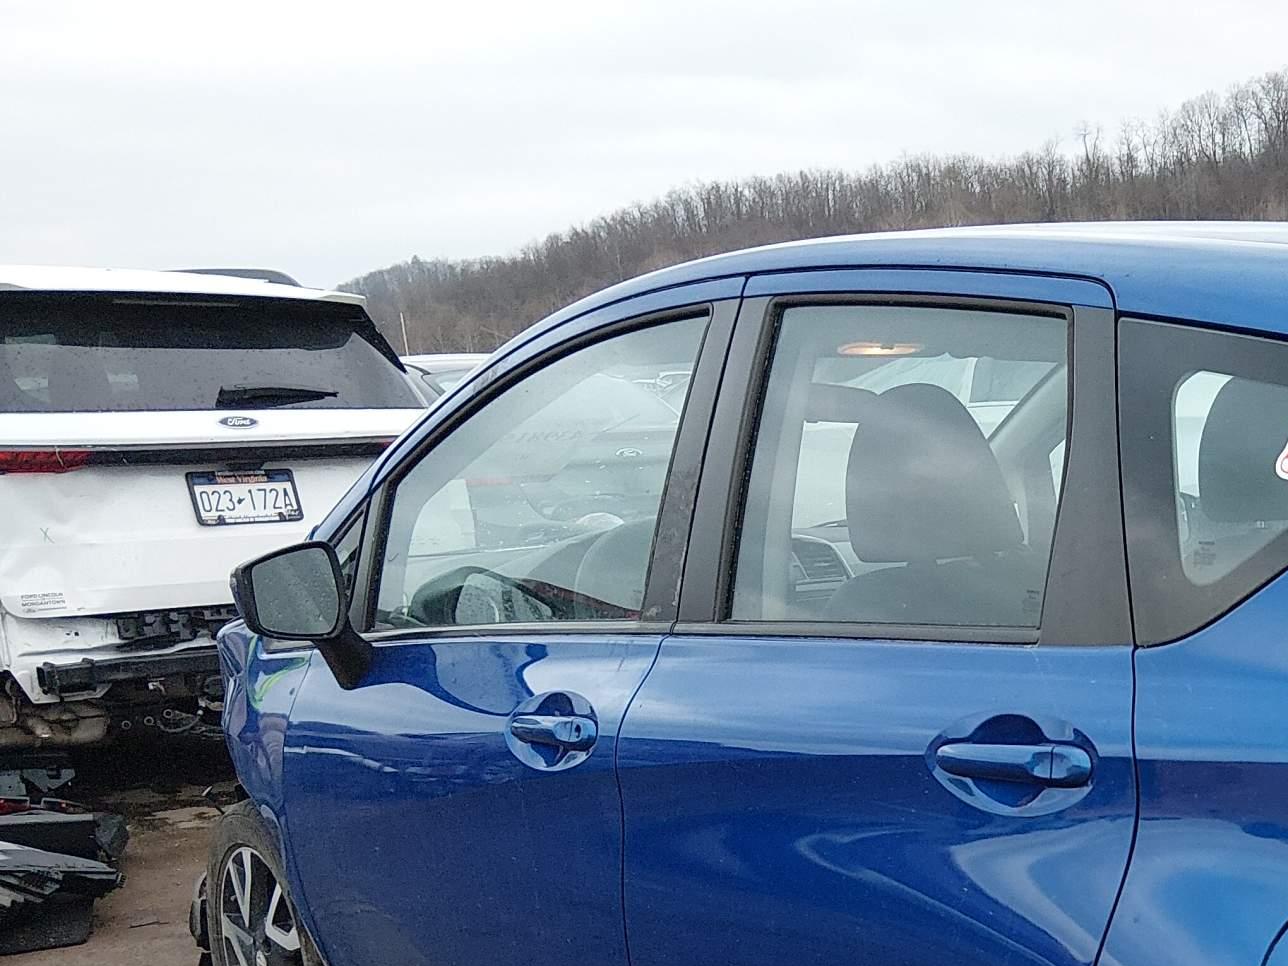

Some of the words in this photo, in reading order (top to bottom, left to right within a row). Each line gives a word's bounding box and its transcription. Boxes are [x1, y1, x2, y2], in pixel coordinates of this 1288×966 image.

[215, 475, 235, 484] West
[235, 474, 268, 483] Virginia
[199, 490, 236, 513] 023
[247, 487, 294, 511] 172A
